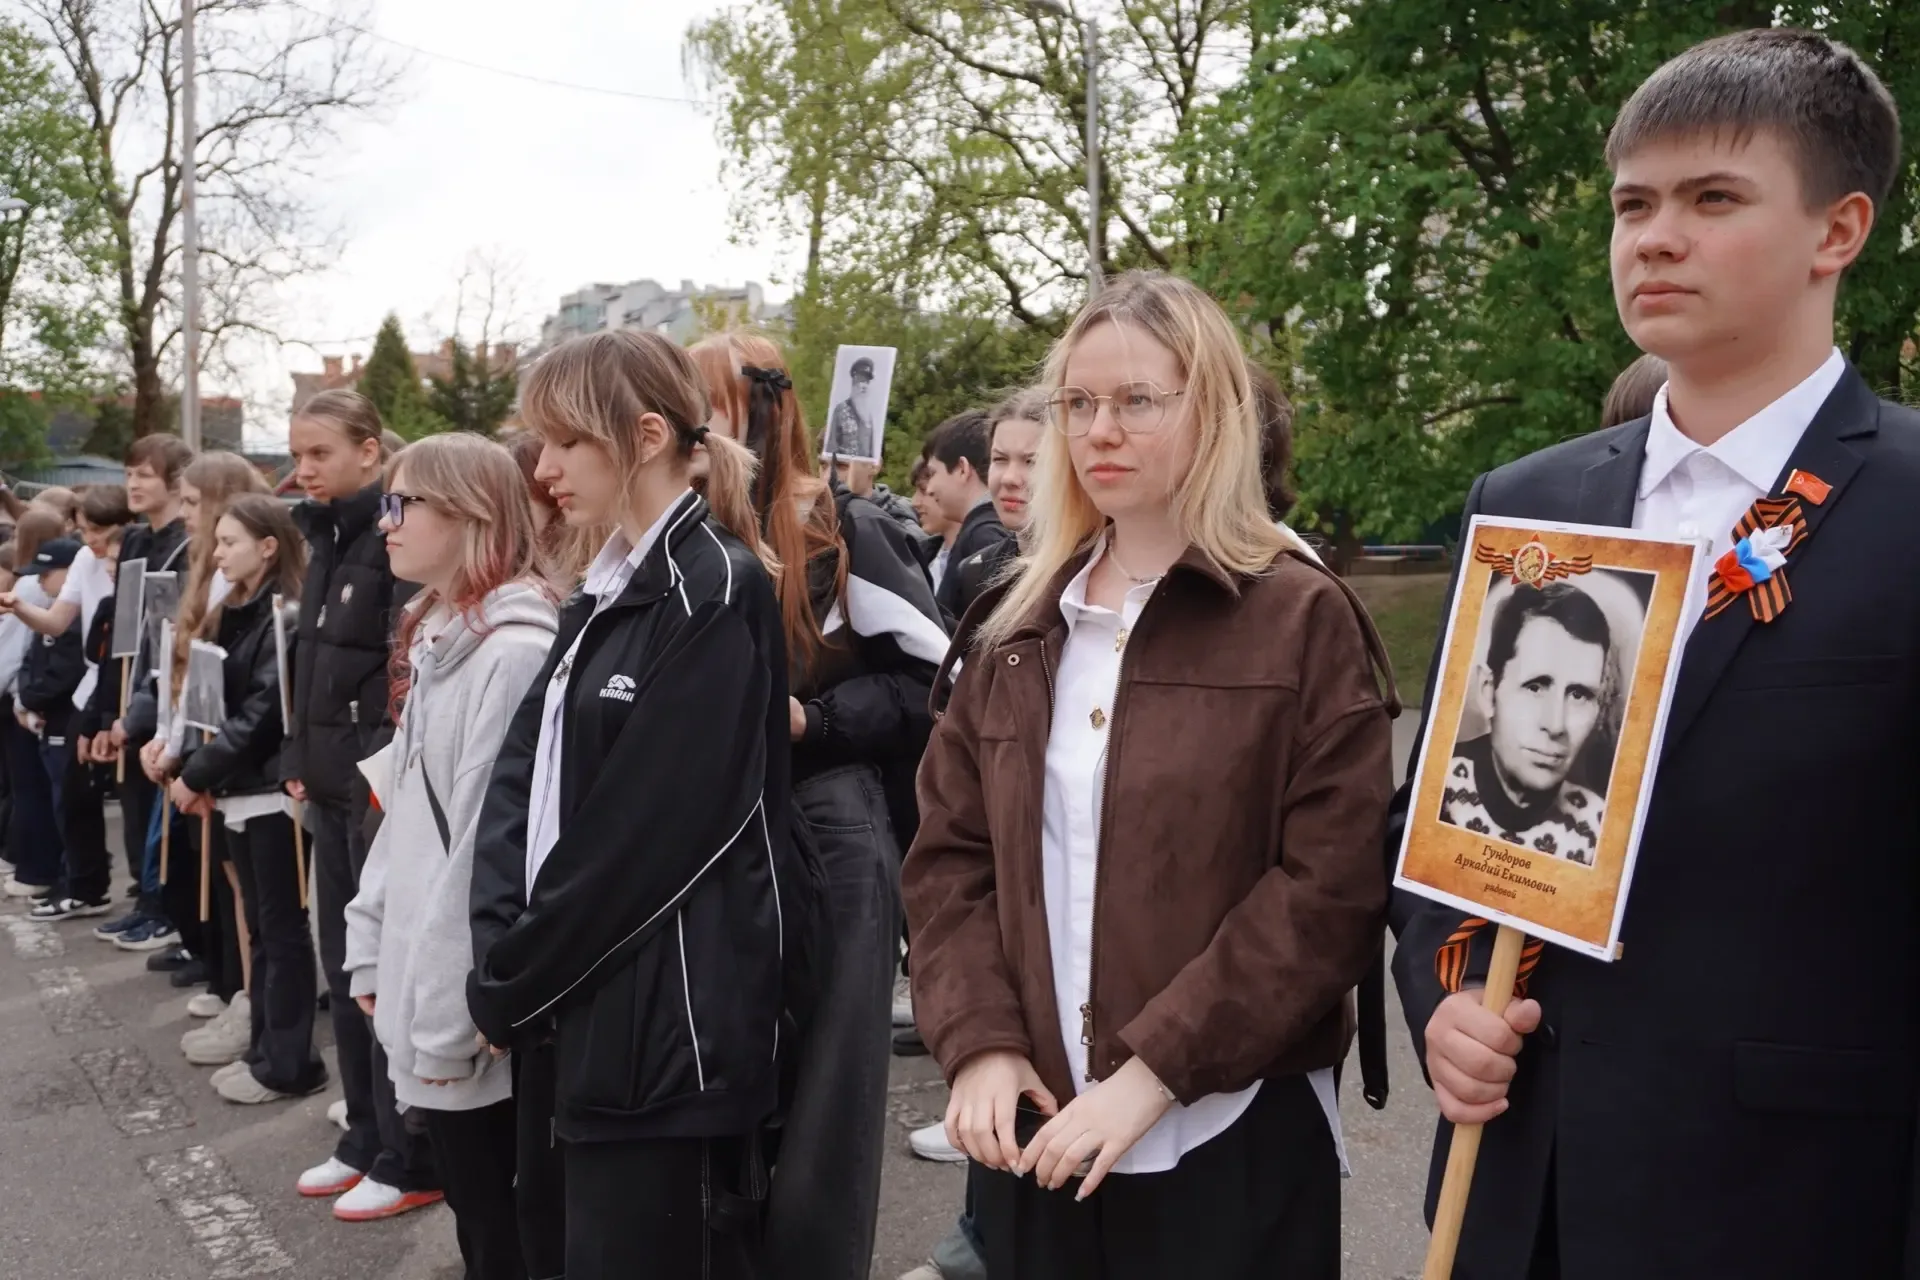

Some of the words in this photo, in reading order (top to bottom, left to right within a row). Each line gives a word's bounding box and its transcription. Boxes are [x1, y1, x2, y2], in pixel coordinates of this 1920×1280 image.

[1454, 853, 1501, 877] Аркадий
[1501, 869, 1557, 895] Екимович
[1482, 844, 1532, 870] Гундоров
